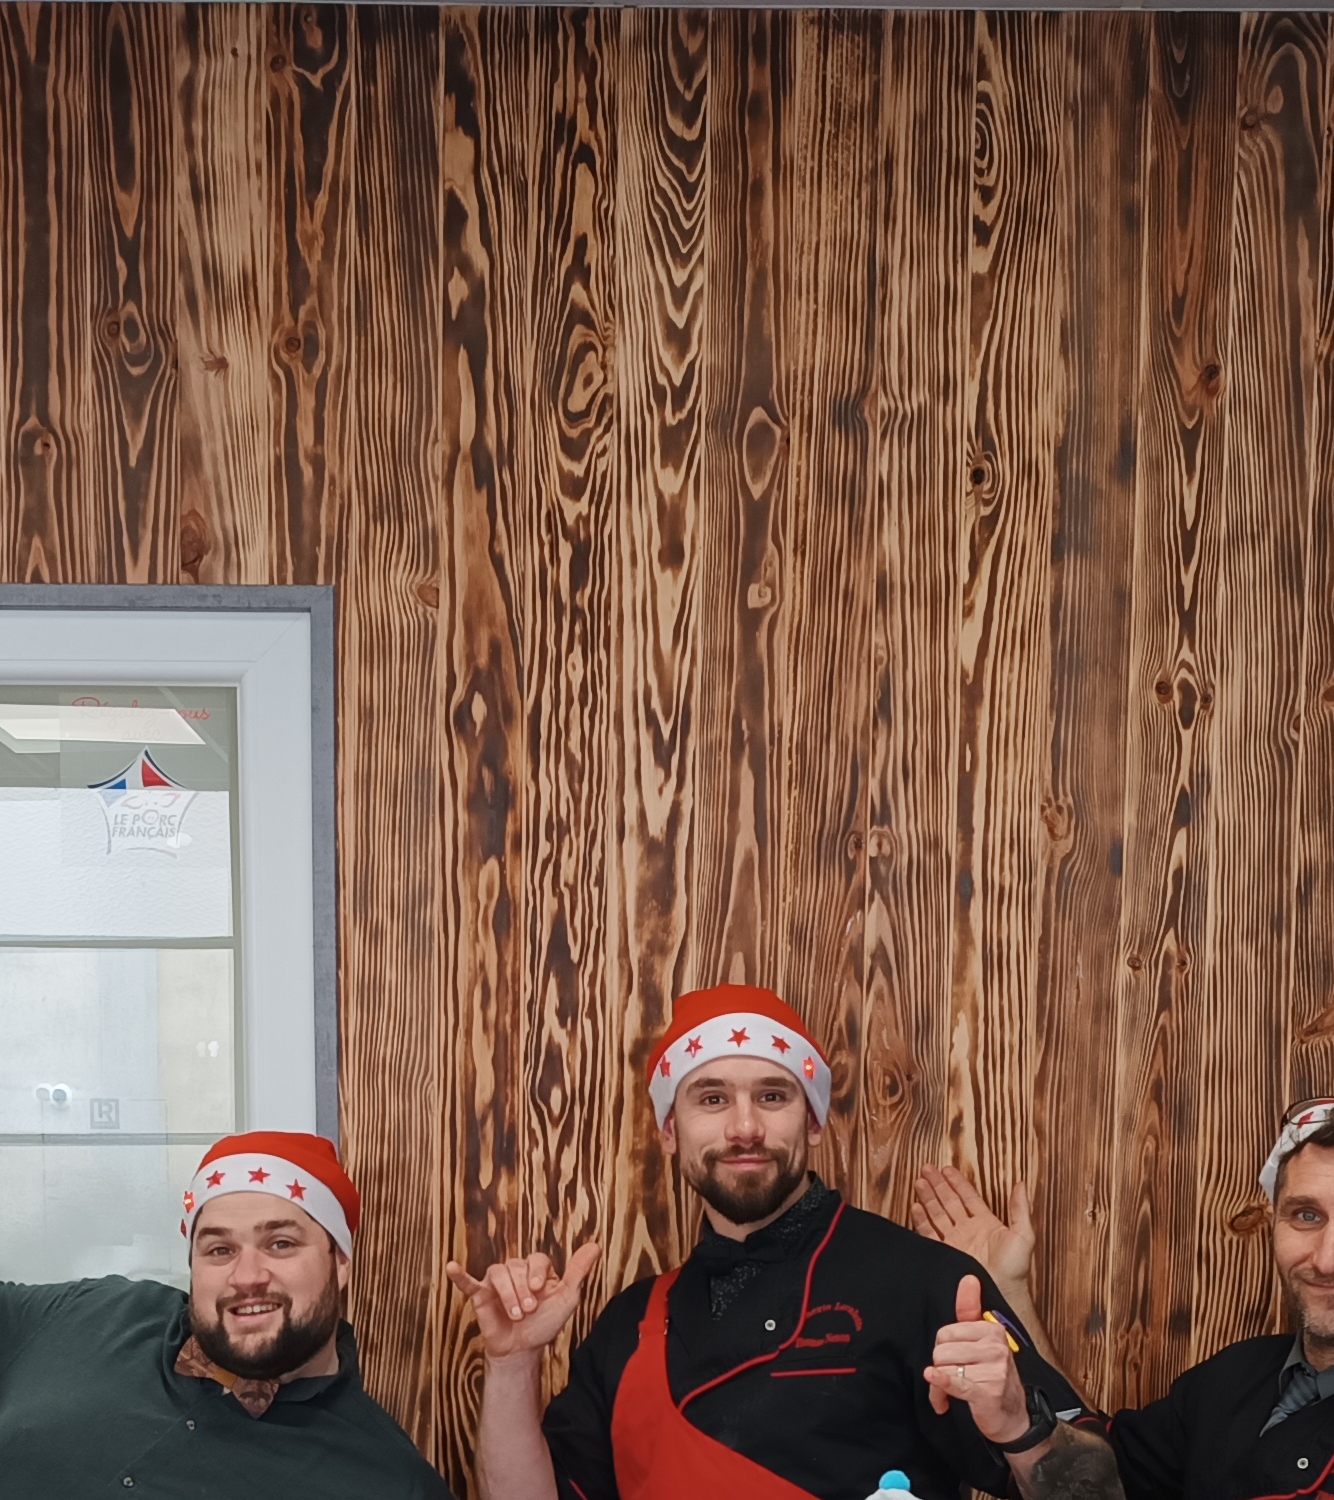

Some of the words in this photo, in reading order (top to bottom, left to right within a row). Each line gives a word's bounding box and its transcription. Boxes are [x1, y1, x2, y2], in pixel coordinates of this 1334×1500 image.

[114, 813, 128, 826] LE
[132, 808, 178, 826] PORC
[112, 826, 176, 840] FRANÇAIS
